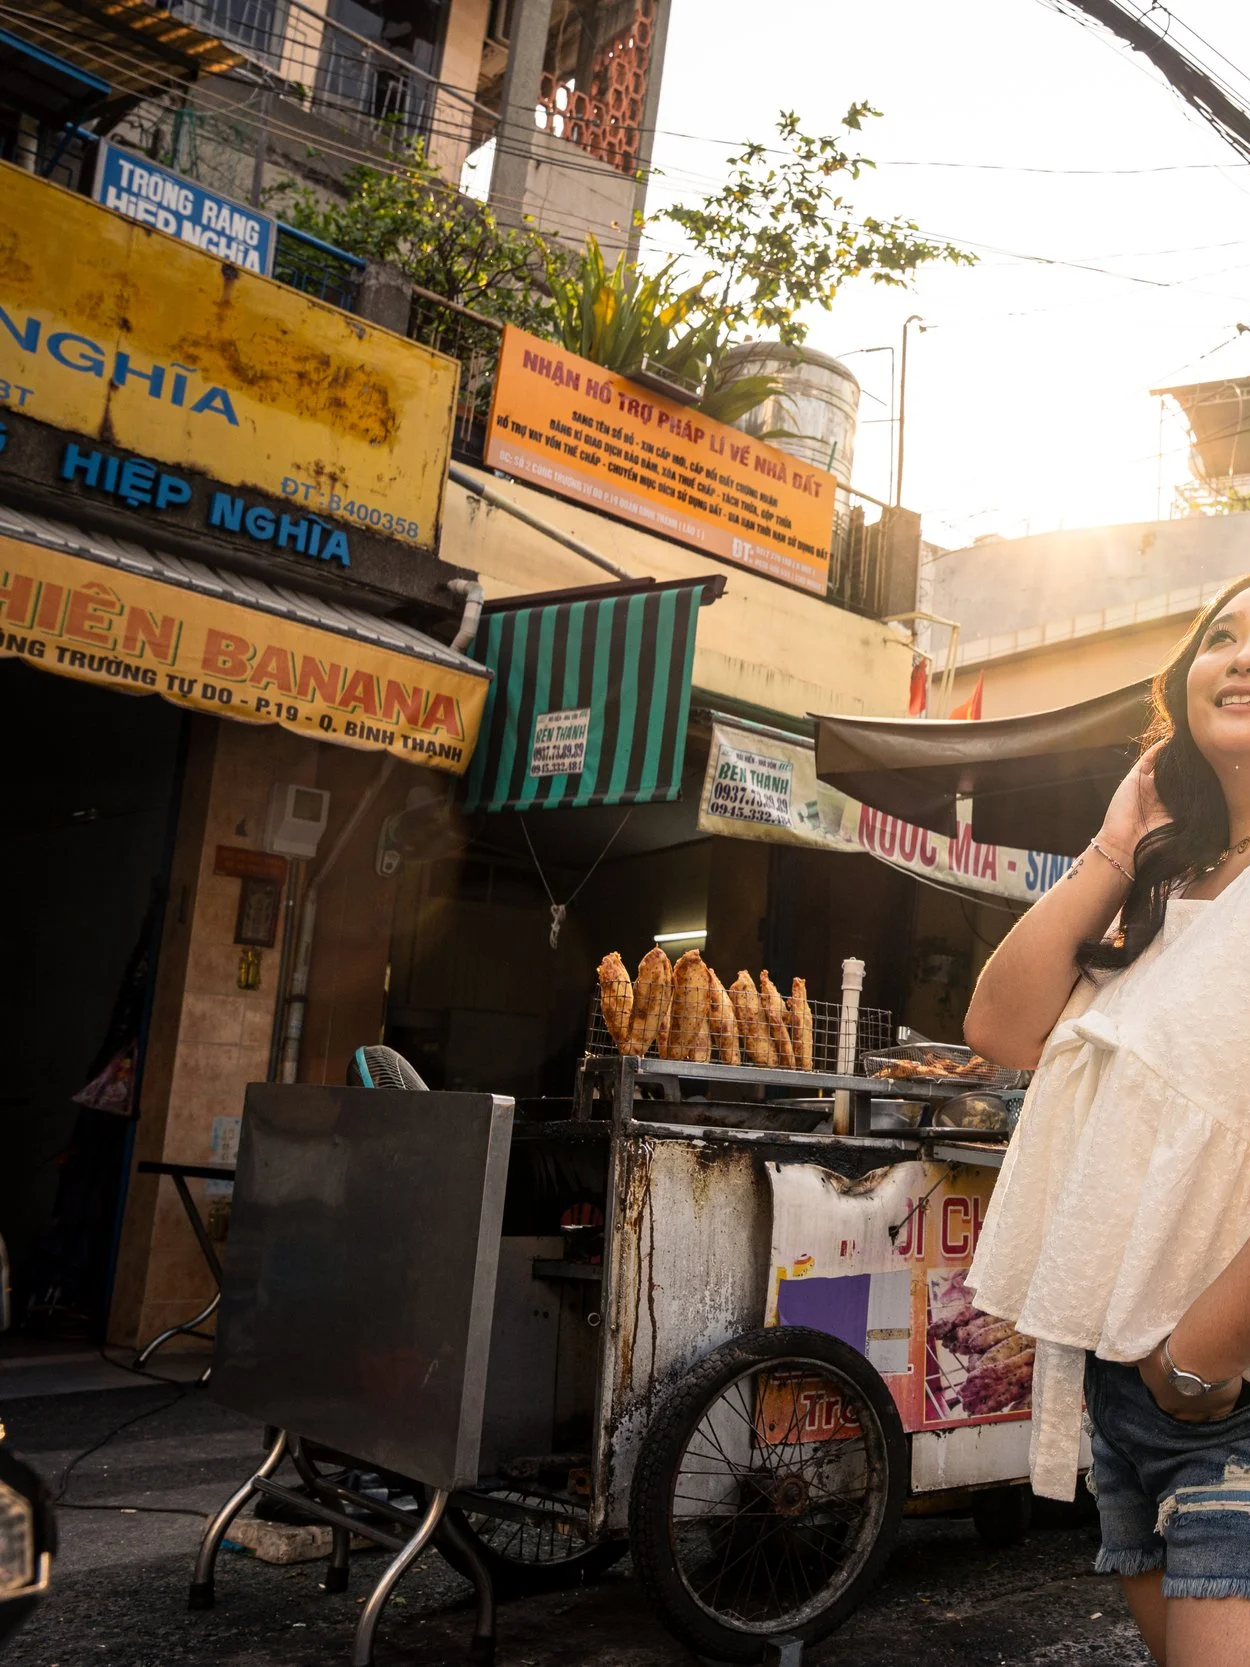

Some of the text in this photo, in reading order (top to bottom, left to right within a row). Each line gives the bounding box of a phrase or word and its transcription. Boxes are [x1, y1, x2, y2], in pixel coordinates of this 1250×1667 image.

[523, 350, 581, 391] NHẬN
[657, 410, 705, 444] PHÁP
[572, 411, 594, 428] SANG
[60, 443, 351, 567] HIỆP NGHĨA
[328, 494, 419, 539] 8400358
[56, 645, 157, 686] TRƯỜNG
[165, 673, 198, 699] TỰ
[255, 697, 299, 722] P.19
[345, 721, 394, 746] BÌNH
[401, 734, 462, 762] THẠNH
[201, 628, 465, 741] BANANA
